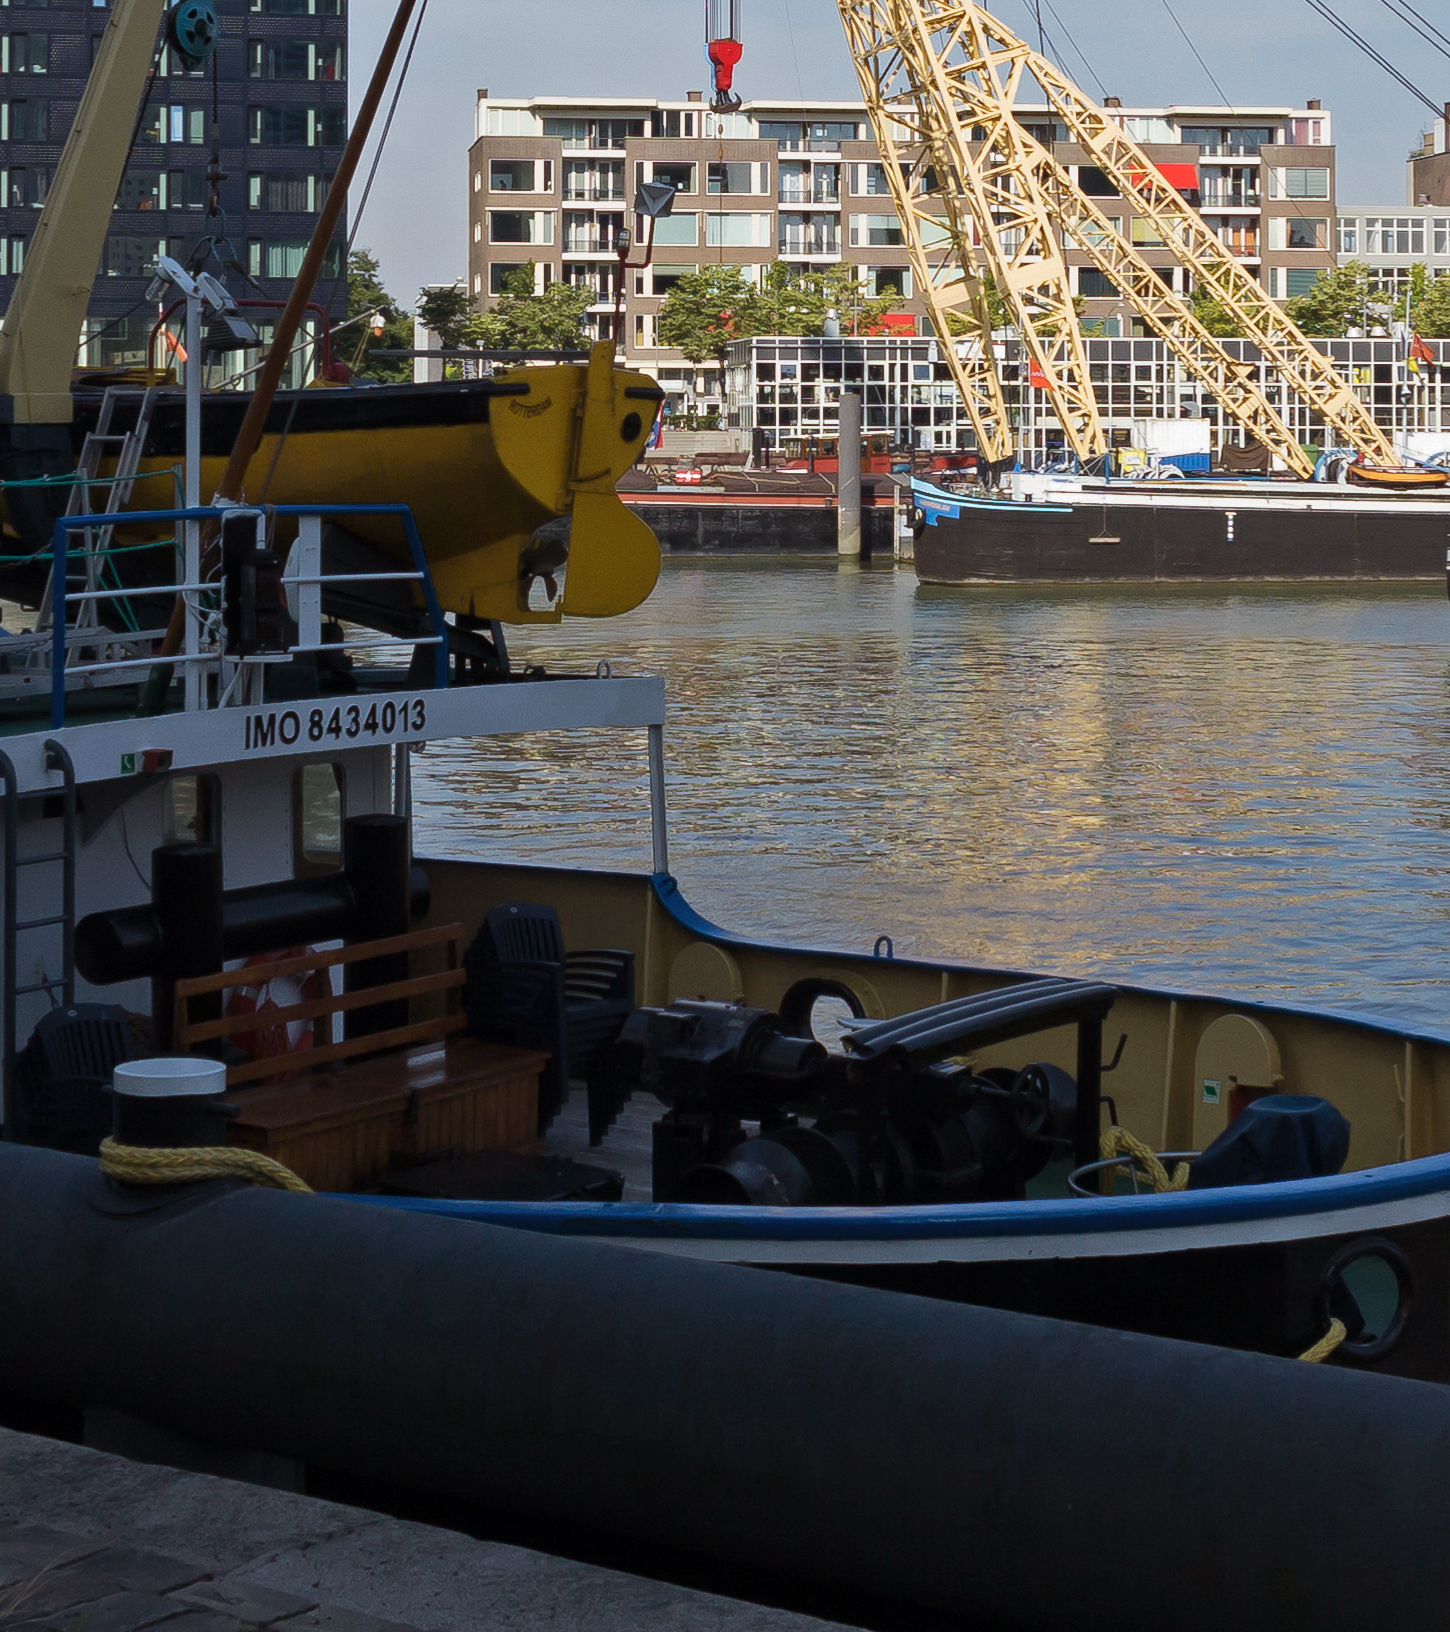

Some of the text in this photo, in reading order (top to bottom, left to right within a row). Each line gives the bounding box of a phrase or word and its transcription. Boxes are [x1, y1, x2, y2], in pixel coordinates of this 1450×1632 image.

[508, 396, 553, 418] ROTTERDAM
[244, 699, 426, 751] IMO 8434013
